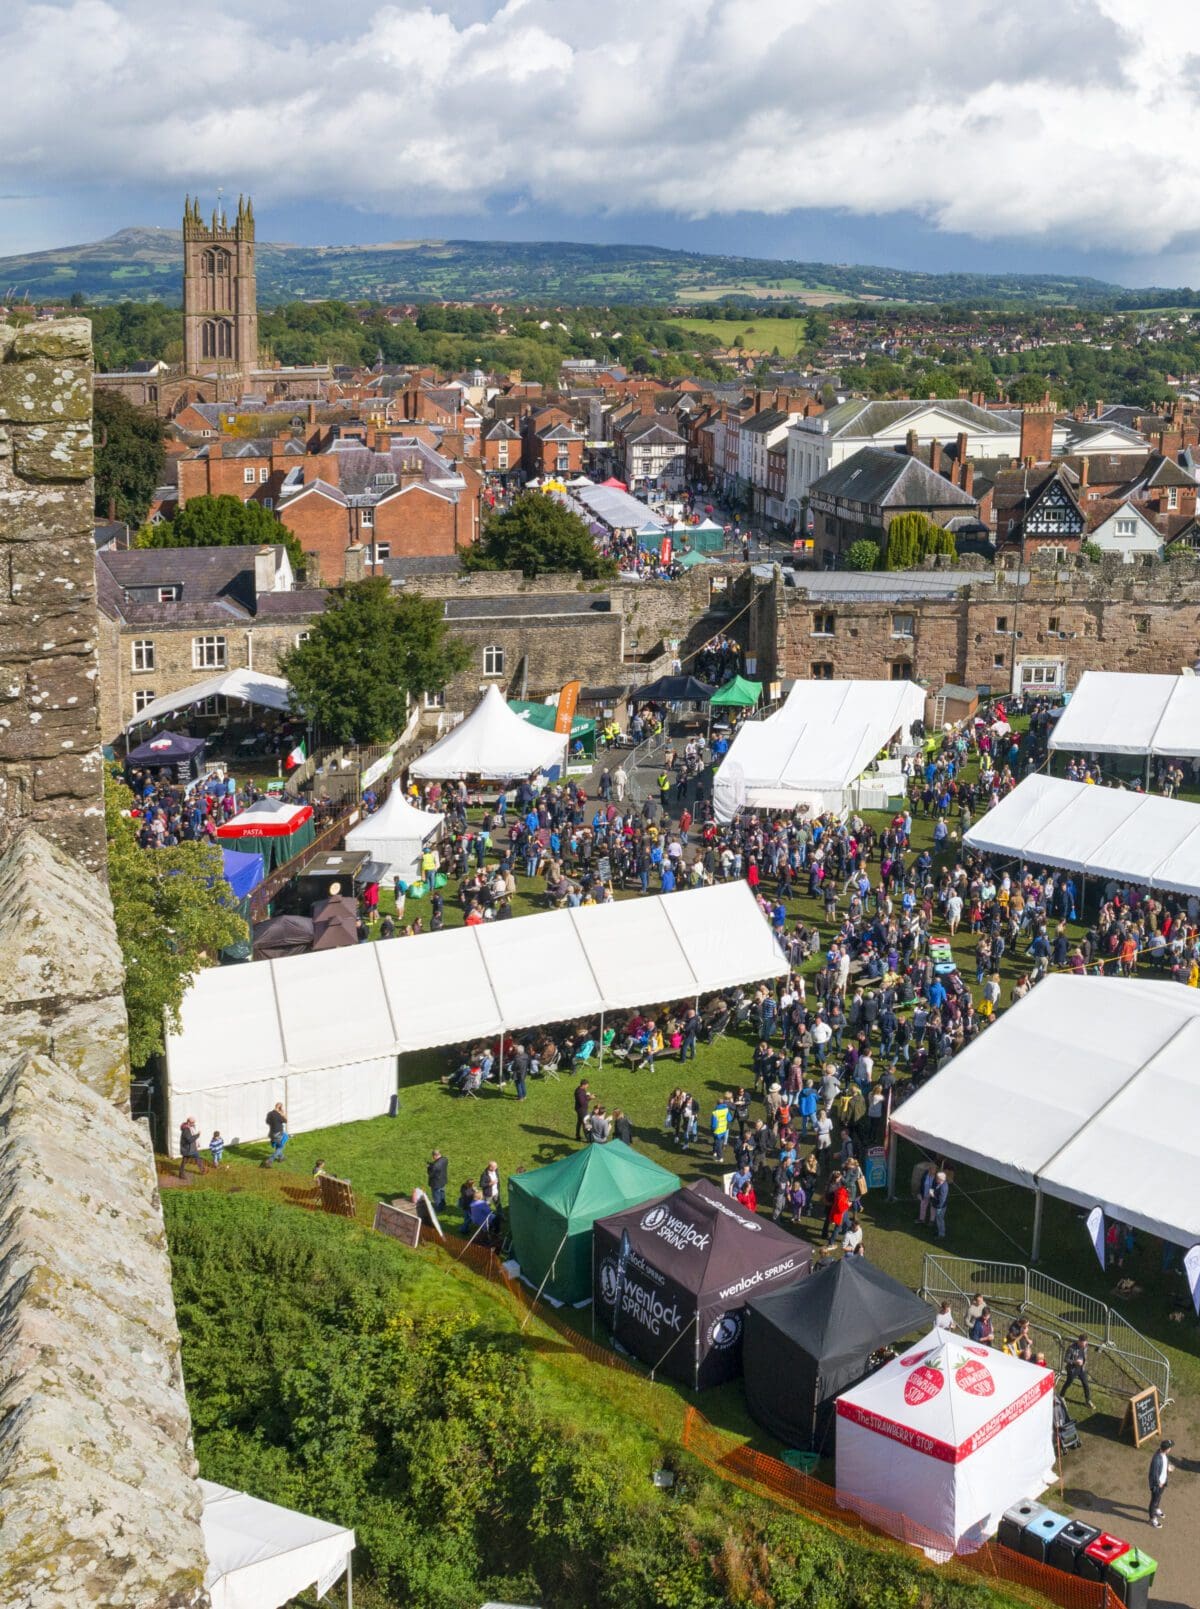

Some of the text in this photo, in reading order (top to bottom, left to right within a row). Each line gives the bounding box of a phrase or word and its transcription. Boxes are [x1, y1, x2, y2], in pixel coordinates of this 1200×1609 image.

[242, 828, 264, 836] PASTA
[657, 1225, 689, 1250] SPRING
[666, 1215, 710, 1251] wenlock
[630, 1252, 666, 1286] lock SPRING
[719, 1259, 794, 1299] wenlock SPRING
[621, 1295, 660, 1336] SPRING
[623, 1278, 682, 1332] wenlock
[906, 1386, 925, 1402] STOP
[856, 1410, 935, 1453] The STRAWBERRY STOP
